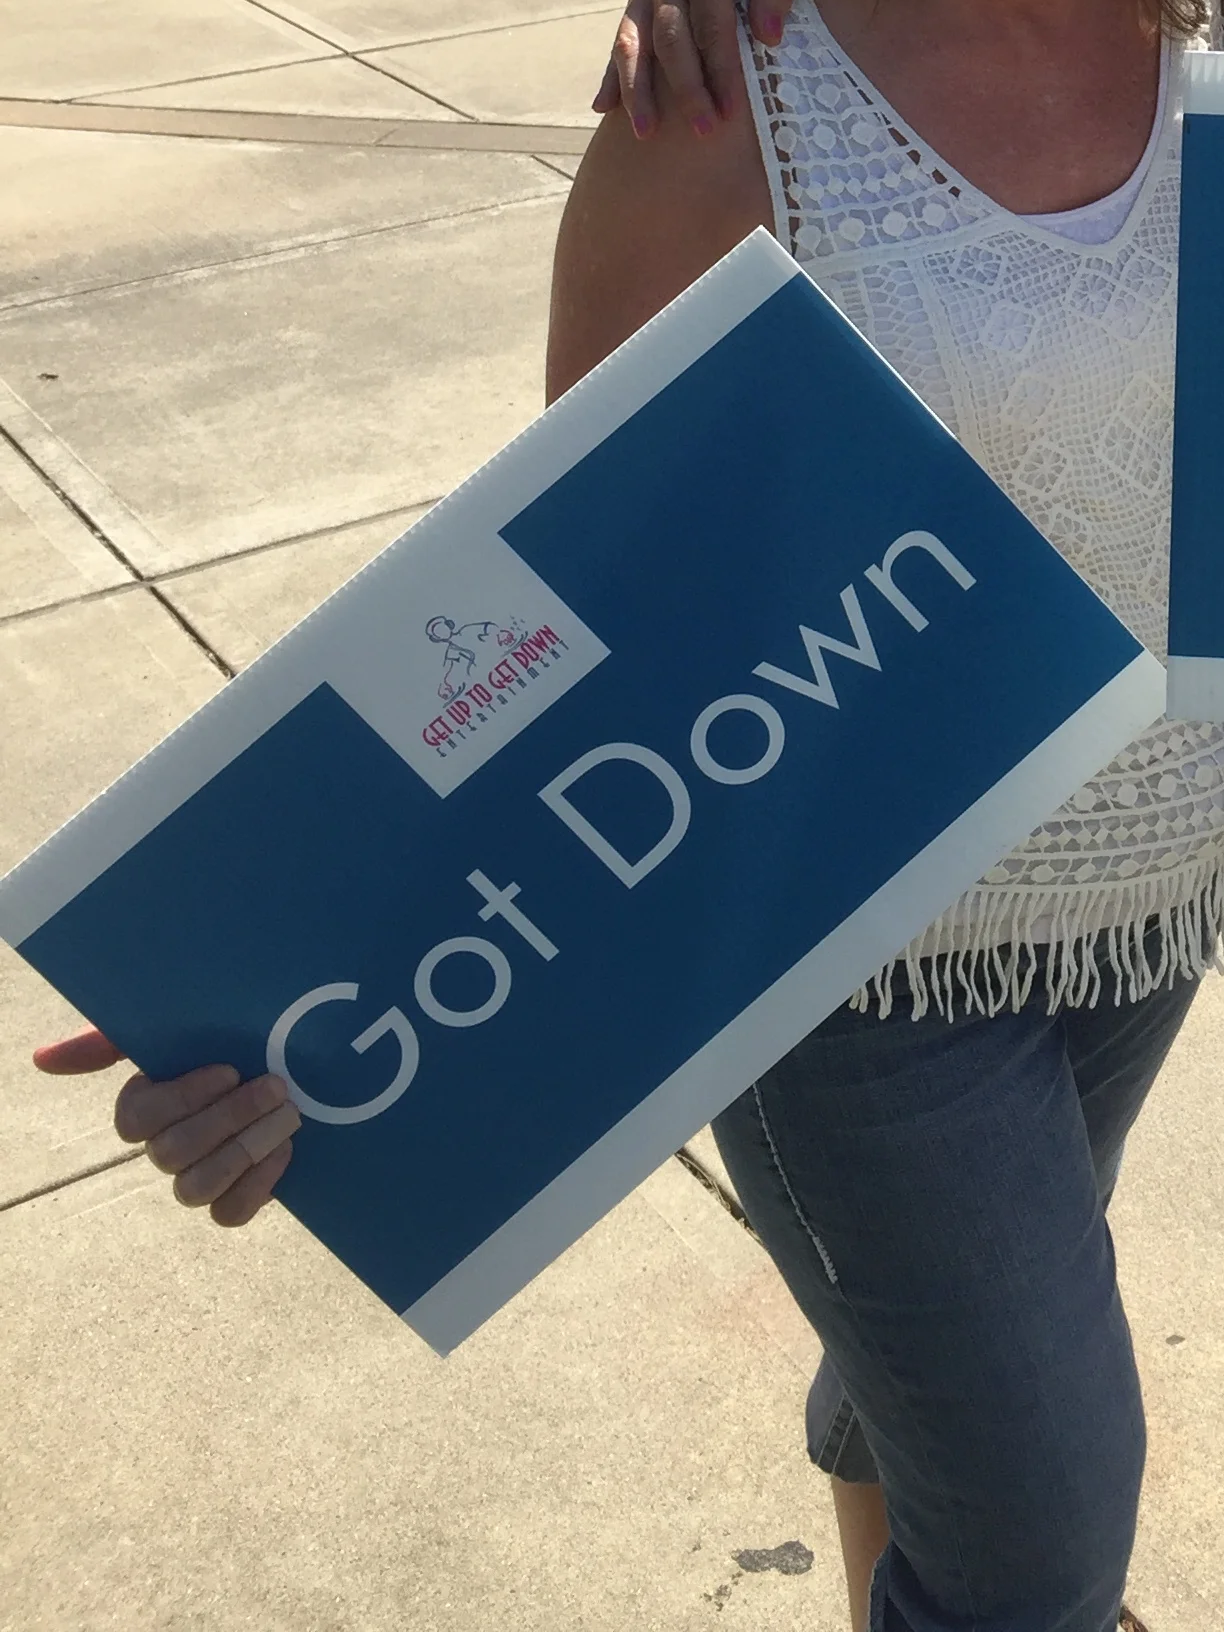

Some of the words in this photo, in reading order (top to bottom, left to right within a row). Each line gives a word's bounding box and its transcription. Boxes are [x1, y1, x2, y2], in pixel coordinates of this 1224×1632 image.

[266, 866, 560, 1126] Got
[537, 530, 977, 890] Down
[422, 715, 455, 747] GET
[445, 699, 472, 726] UP
[465, 682, 494, 708] TO
[487, 658, 519, 690] GET
[510, 623, 560, 670] DOWN
